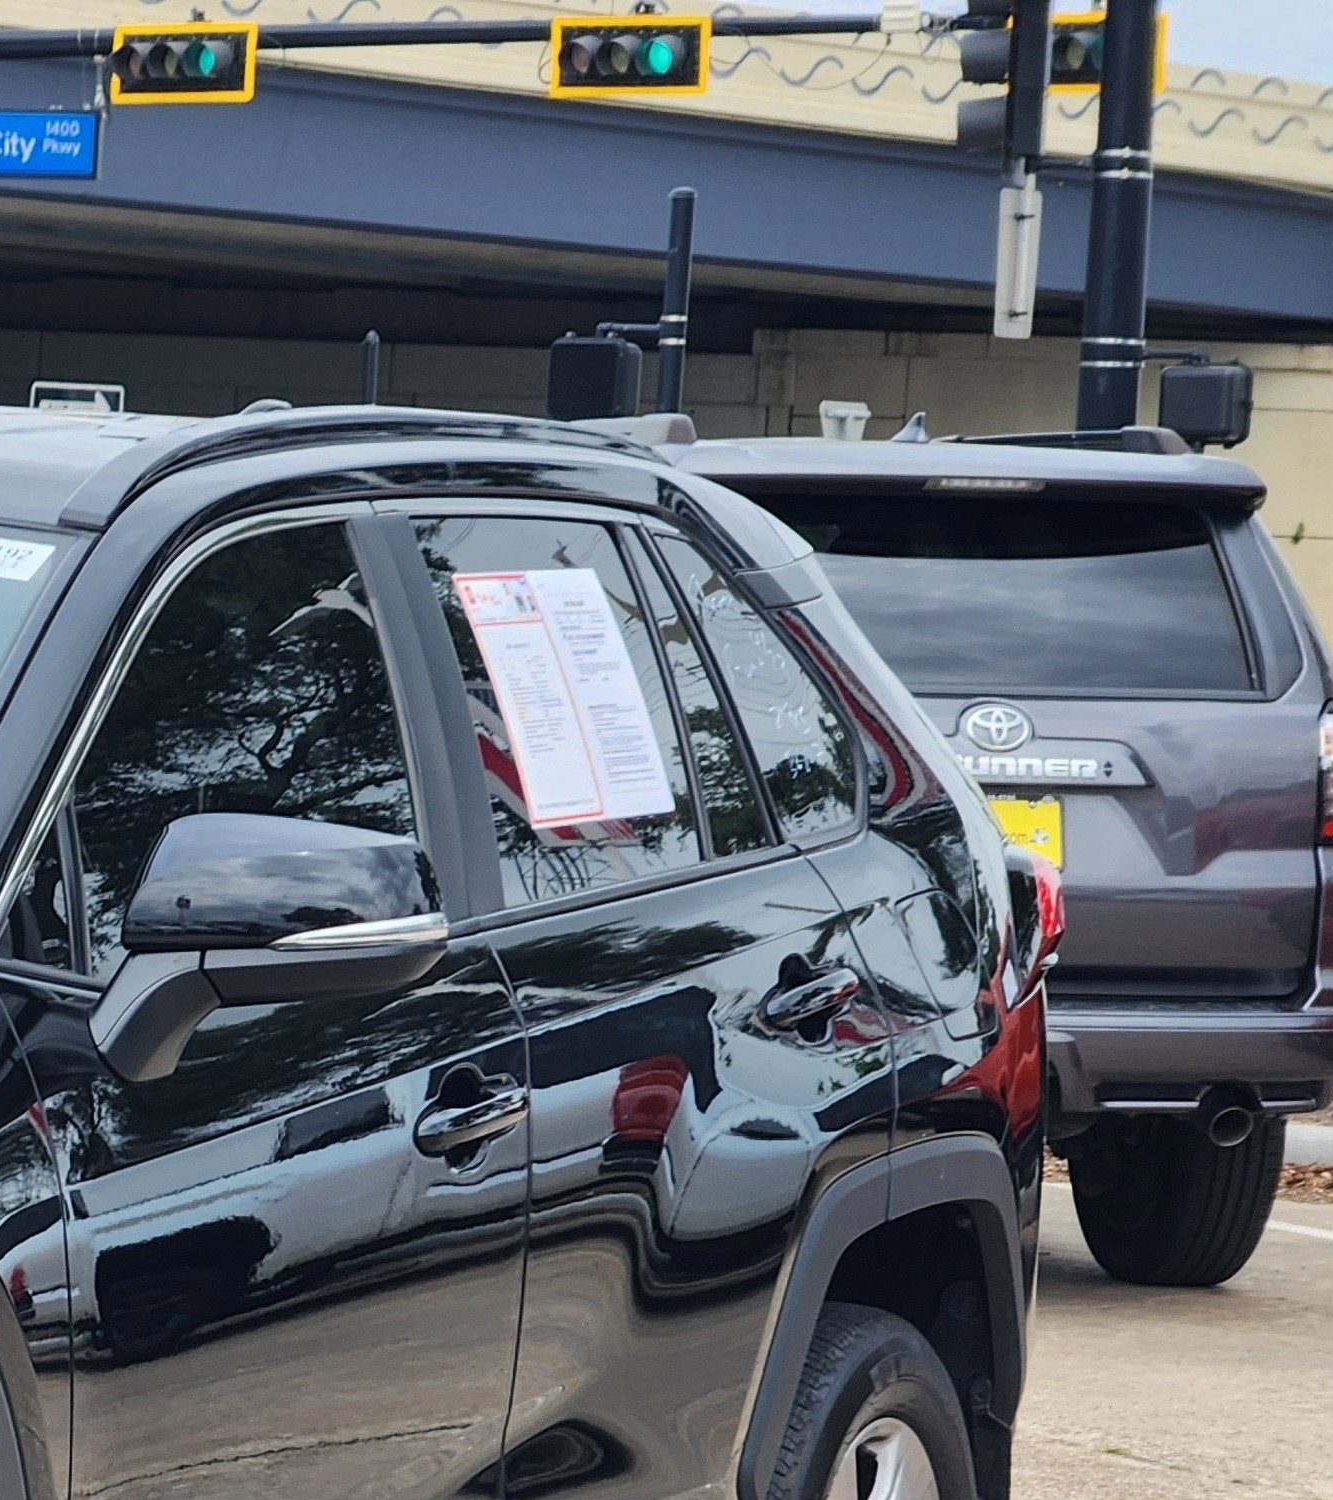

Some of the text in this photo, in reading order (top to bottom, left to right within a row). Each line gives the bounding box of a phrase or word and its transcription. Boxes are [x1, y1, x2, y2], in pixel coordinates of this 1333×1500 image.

[45, 120, 81, 137] 1400
[42, 138, 82, 157] Pkwy
[958, 754, 1098, 778] UNNER
